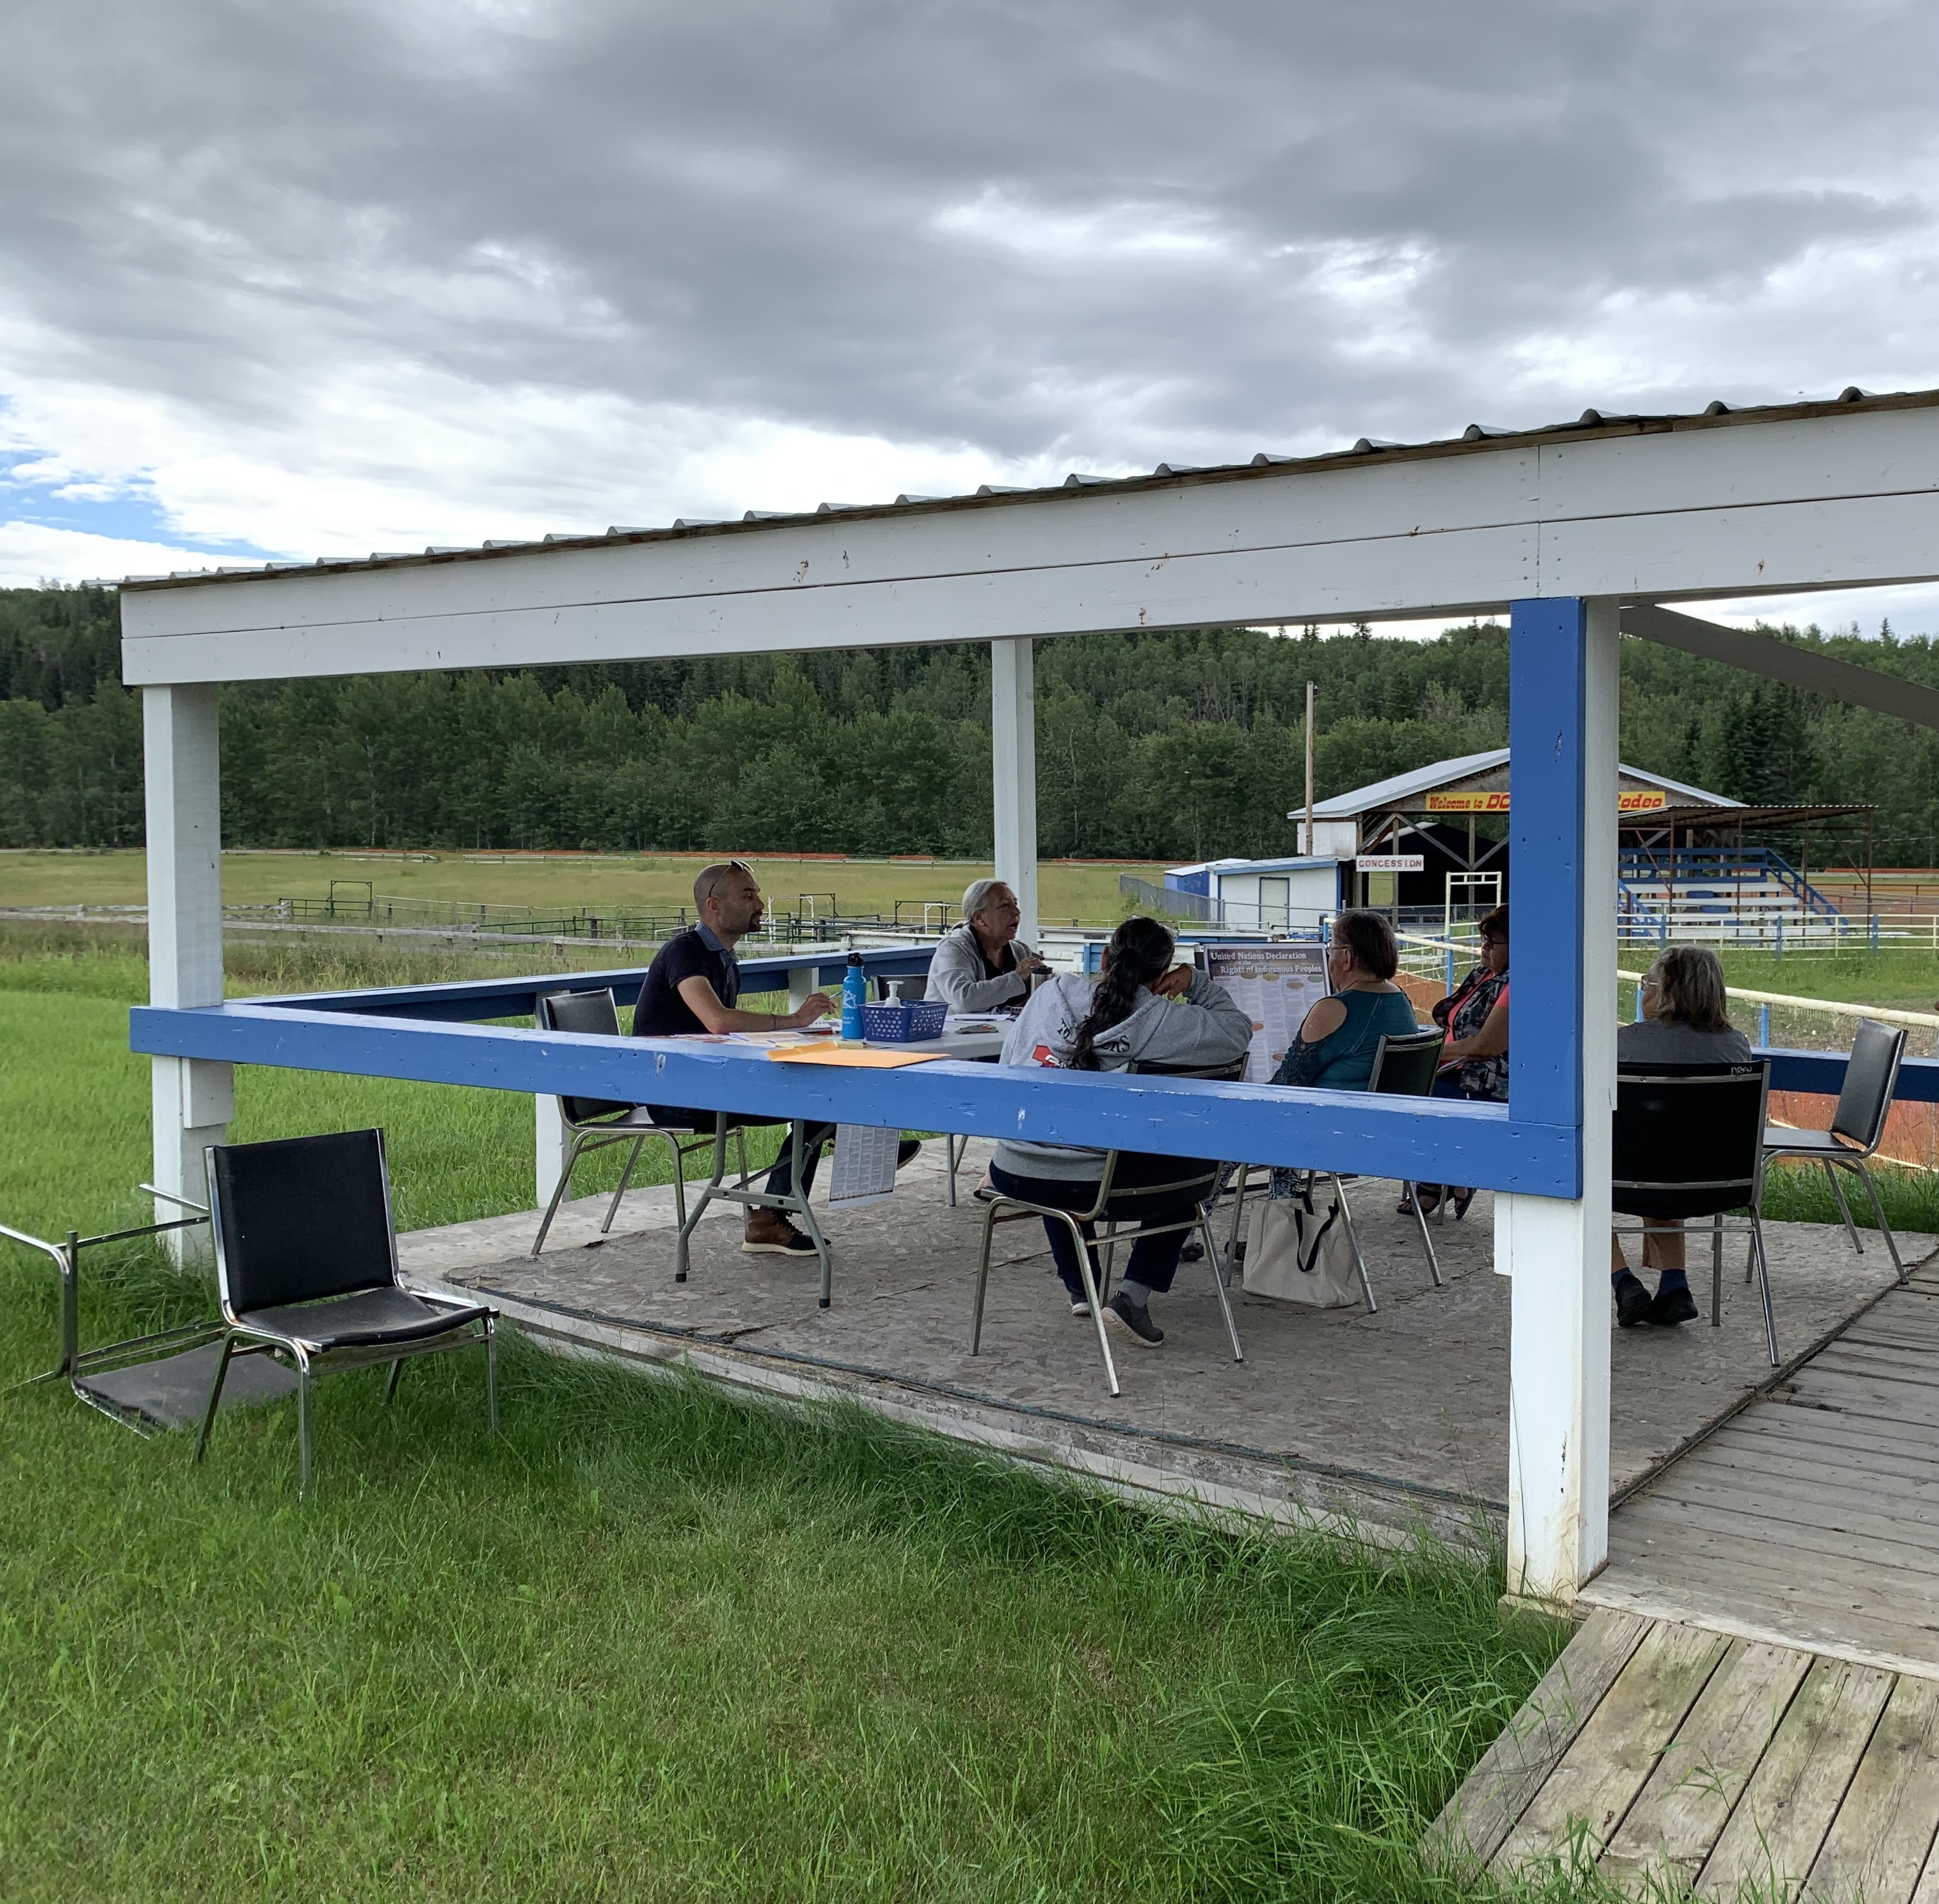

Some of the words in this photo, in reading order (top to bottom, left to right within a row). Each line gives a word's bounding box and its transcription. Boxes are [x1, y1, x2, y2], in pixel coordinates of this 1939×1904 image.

[1430, 796, 1471, 809] Welcome
[1474, 798, 1483, 809] to
[1618, 794, 1662, 808] odeo
[1359, 859, 1422, 868] CONCESSION
[1210, 952, 1235, 960] United
[1237, 951, 1265, 960] Nations
[1265, 951, 1307, 960] Declaration
[1220, 965, 1245, 975] Rights
[1246, 965, 1254, 973] of
[1255, 965, 1294, 974] Indigenous
[1295, 964, 1322, 974] Peoples
